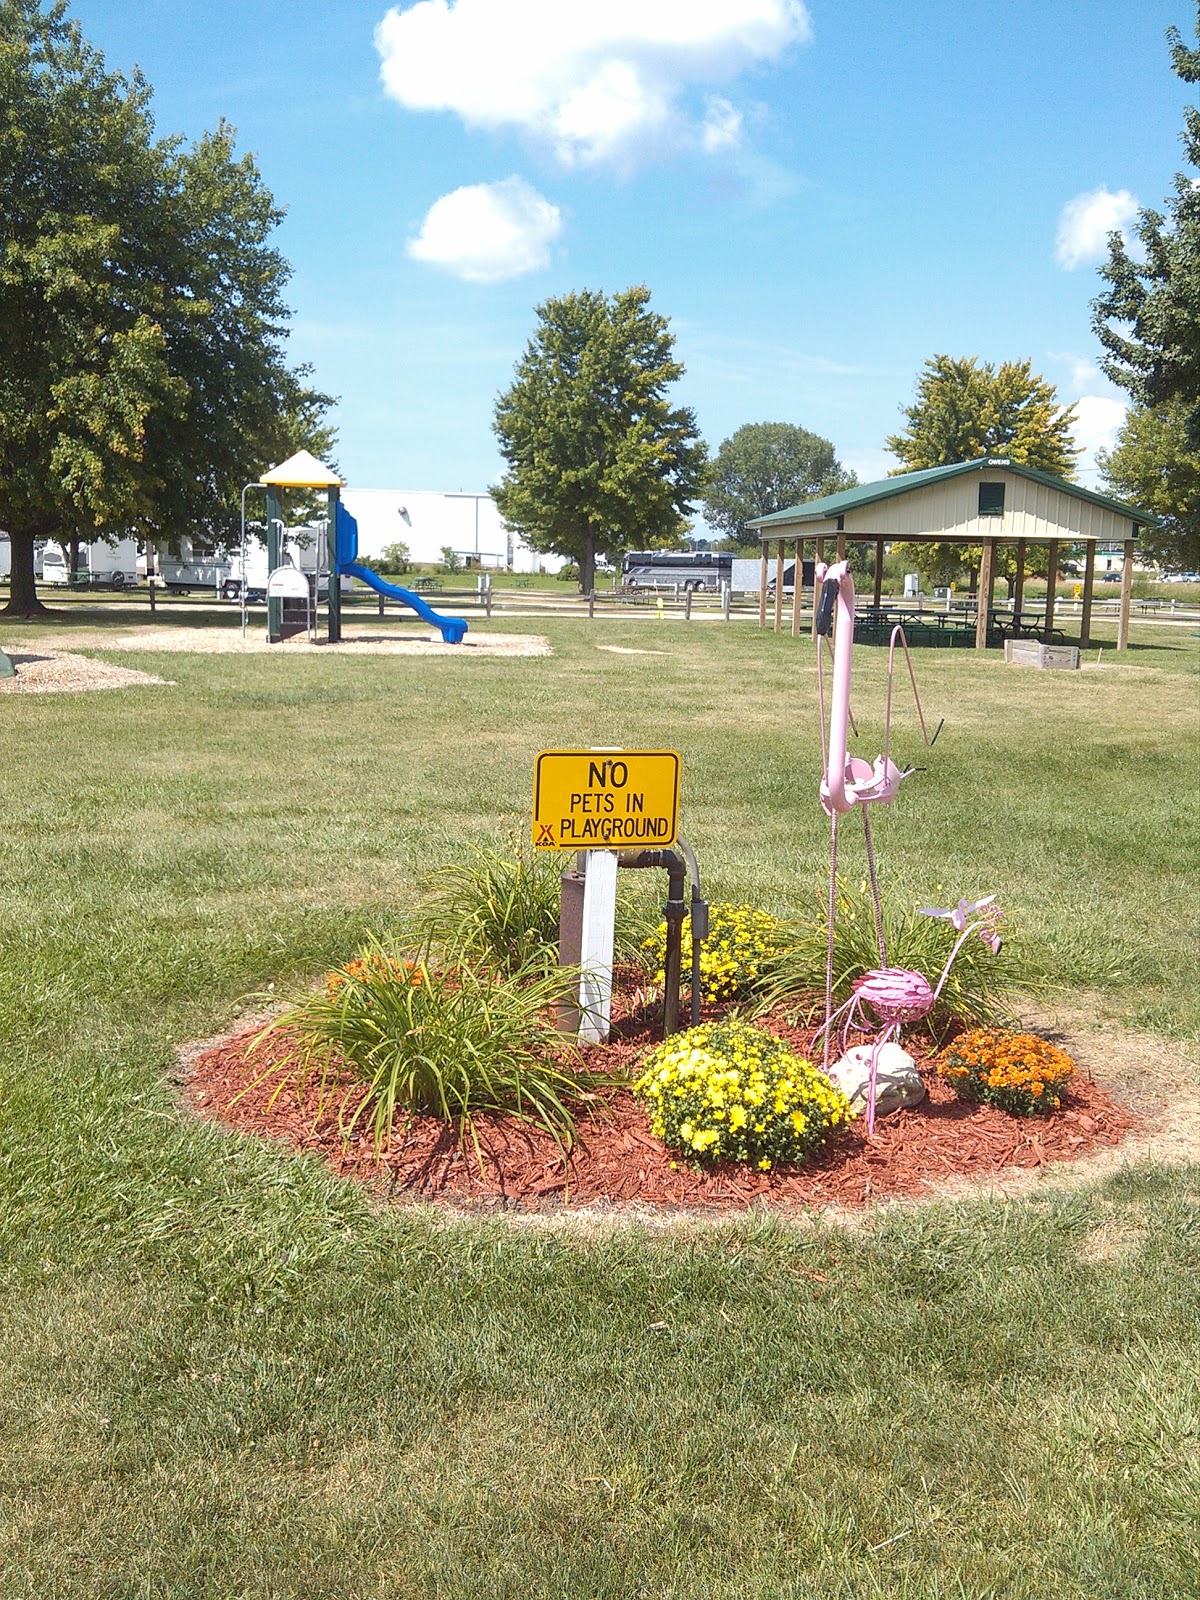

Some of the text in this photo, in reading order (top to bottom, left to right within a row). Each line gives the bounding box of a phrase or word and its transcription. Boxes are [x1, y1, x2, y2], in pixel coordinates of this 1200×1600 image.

[589, 761, 628, 788] NO
[570, 793, 644, 813] PETS IN
[560, 818, 668, 838] PLAYGROUND
